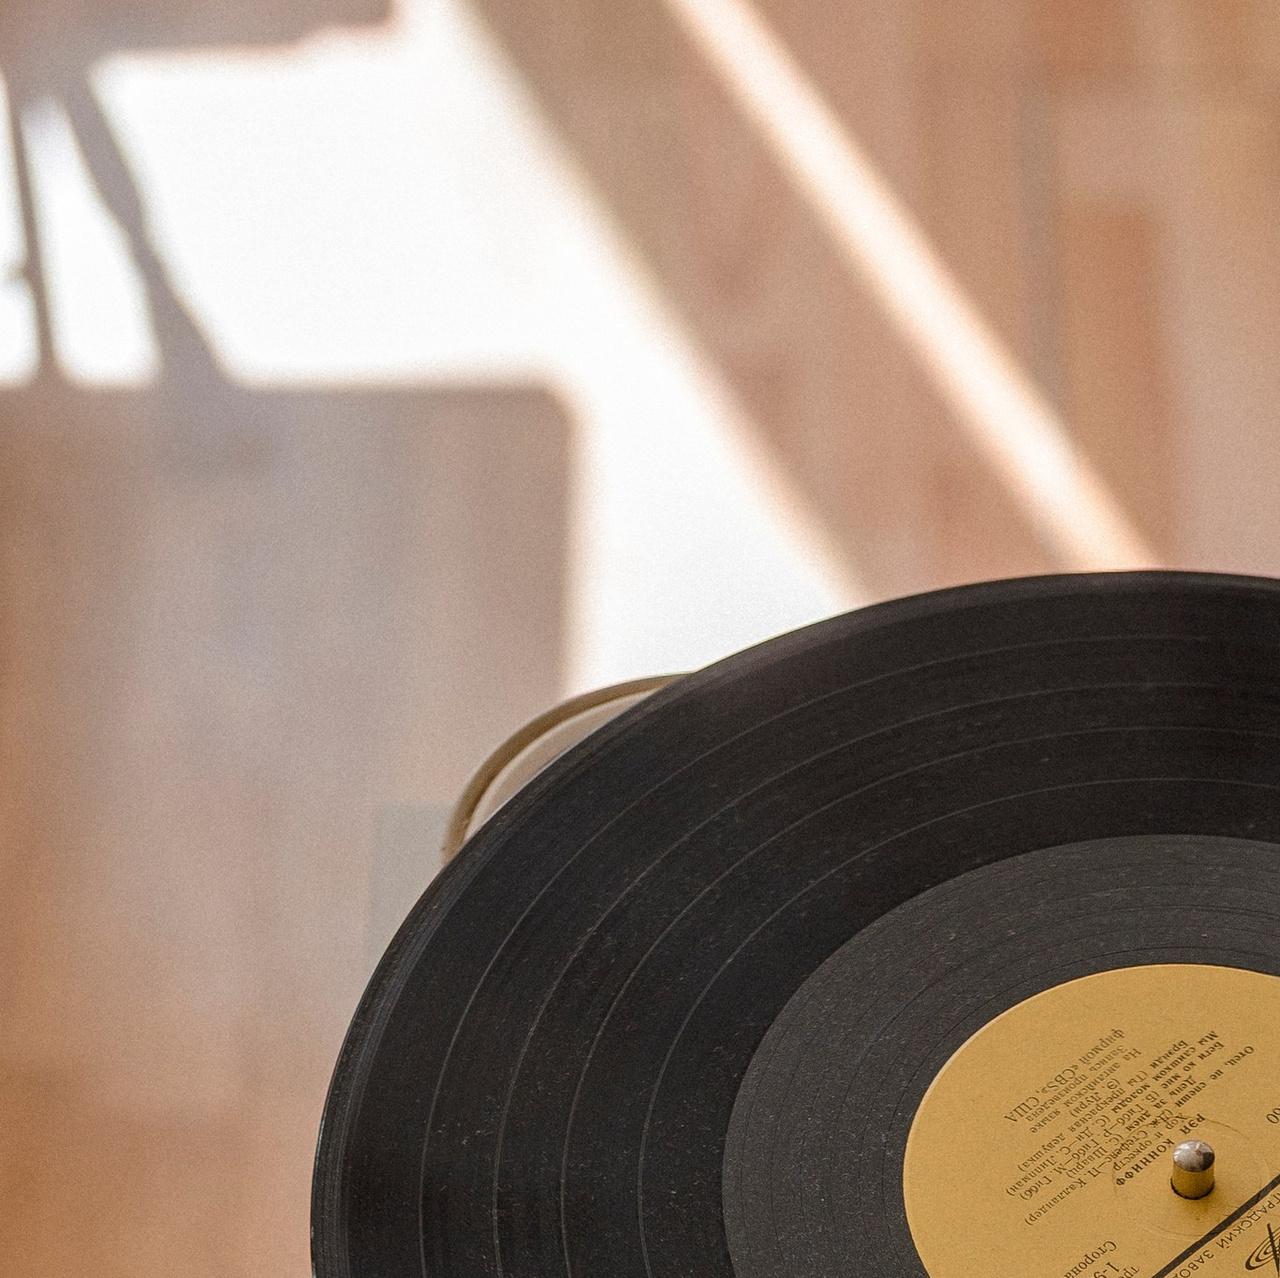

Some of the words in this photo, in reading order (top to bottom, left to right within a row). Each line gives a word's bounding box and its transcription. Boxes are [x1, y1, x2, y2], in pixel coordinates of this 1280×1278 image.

[1077, 1027, 1125, 1066] фирмой
[1195, 1029, 1219, 1046] Мы
[1195, 1040, 1226, 1061] Беги
[1087, 1044, 1128, 1077] Запись
[1120, 1047, 1142, 1061] На
[1148, 1039, 1191, 1069] Брэнди
[1150, 1045, 1197, 1082] слишком
[1181, 1060, 1197, 1072] ко
[1059, 1061, 1121, 1108] английском
[1158, 1071, 1183, 1093] мне
[1167, 1073, 1197, 1099] День
[1002, 1095, 1040, 1127] США
[1024, 1073, 1090, 1123] произведена
[1066, 1083, 1126, 1135] прекрасная
[1108, 1081, 1151, 1116] молоды
[1149, 1097, 1168, 1109] за
[1028, 1107, 1063, 1133] языке
[1122, 1108, 1153, 1135] днем
[1016, 1131, 1067, 1173] девушка)
[1110, 1135, 1156, 1173] оркестр
[1111, 1136, 1176, 1186] КОННИФФ
[1018, 1174, 1053, 1201] Гибб)
